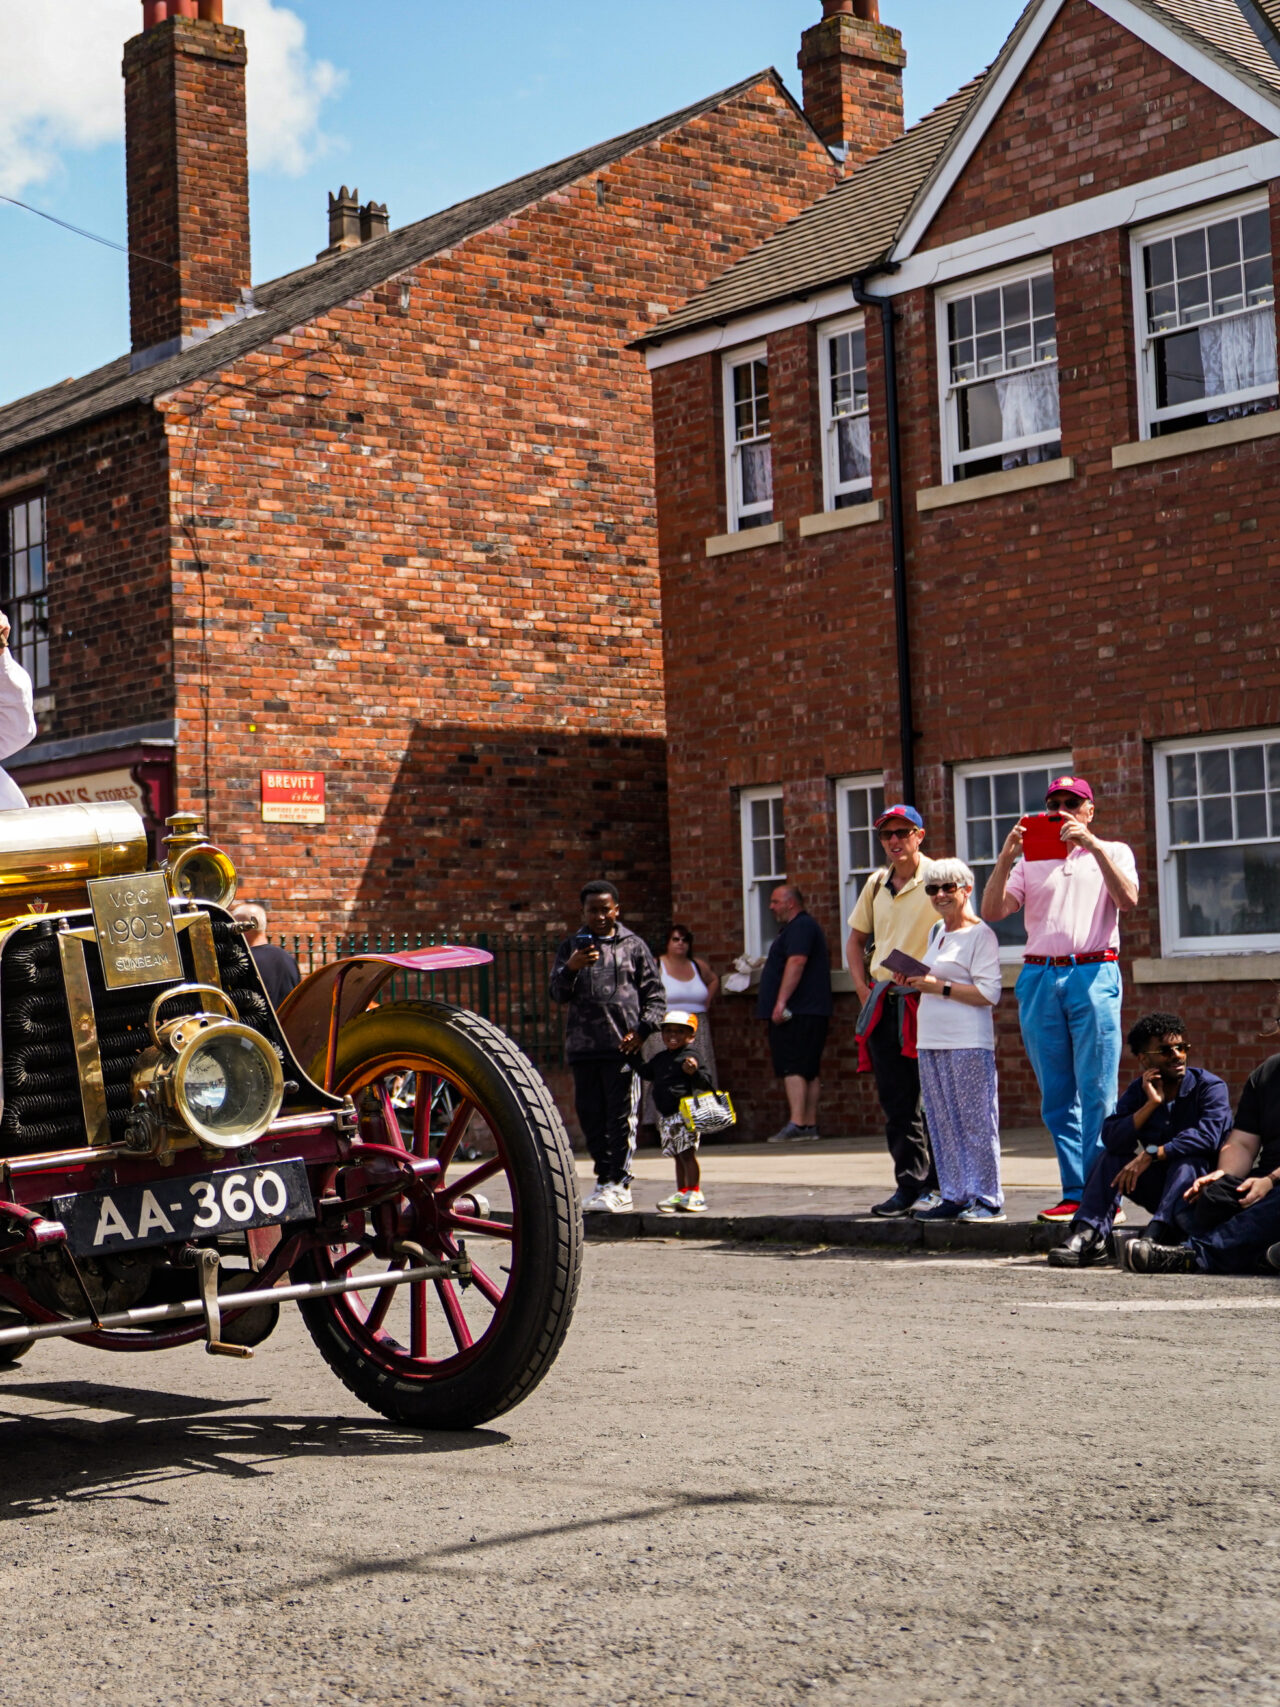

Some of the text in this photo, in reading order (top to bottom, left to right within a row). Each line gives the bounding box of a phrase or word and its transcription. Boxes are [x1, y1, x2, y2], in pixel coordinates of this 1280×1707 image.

[95, 785, 138, 802] STORES
[267, 775, 315, 789] BREVITT
[107, 914, 164, 944] 1903
[92, 1170, 288, 1247] AA-360
